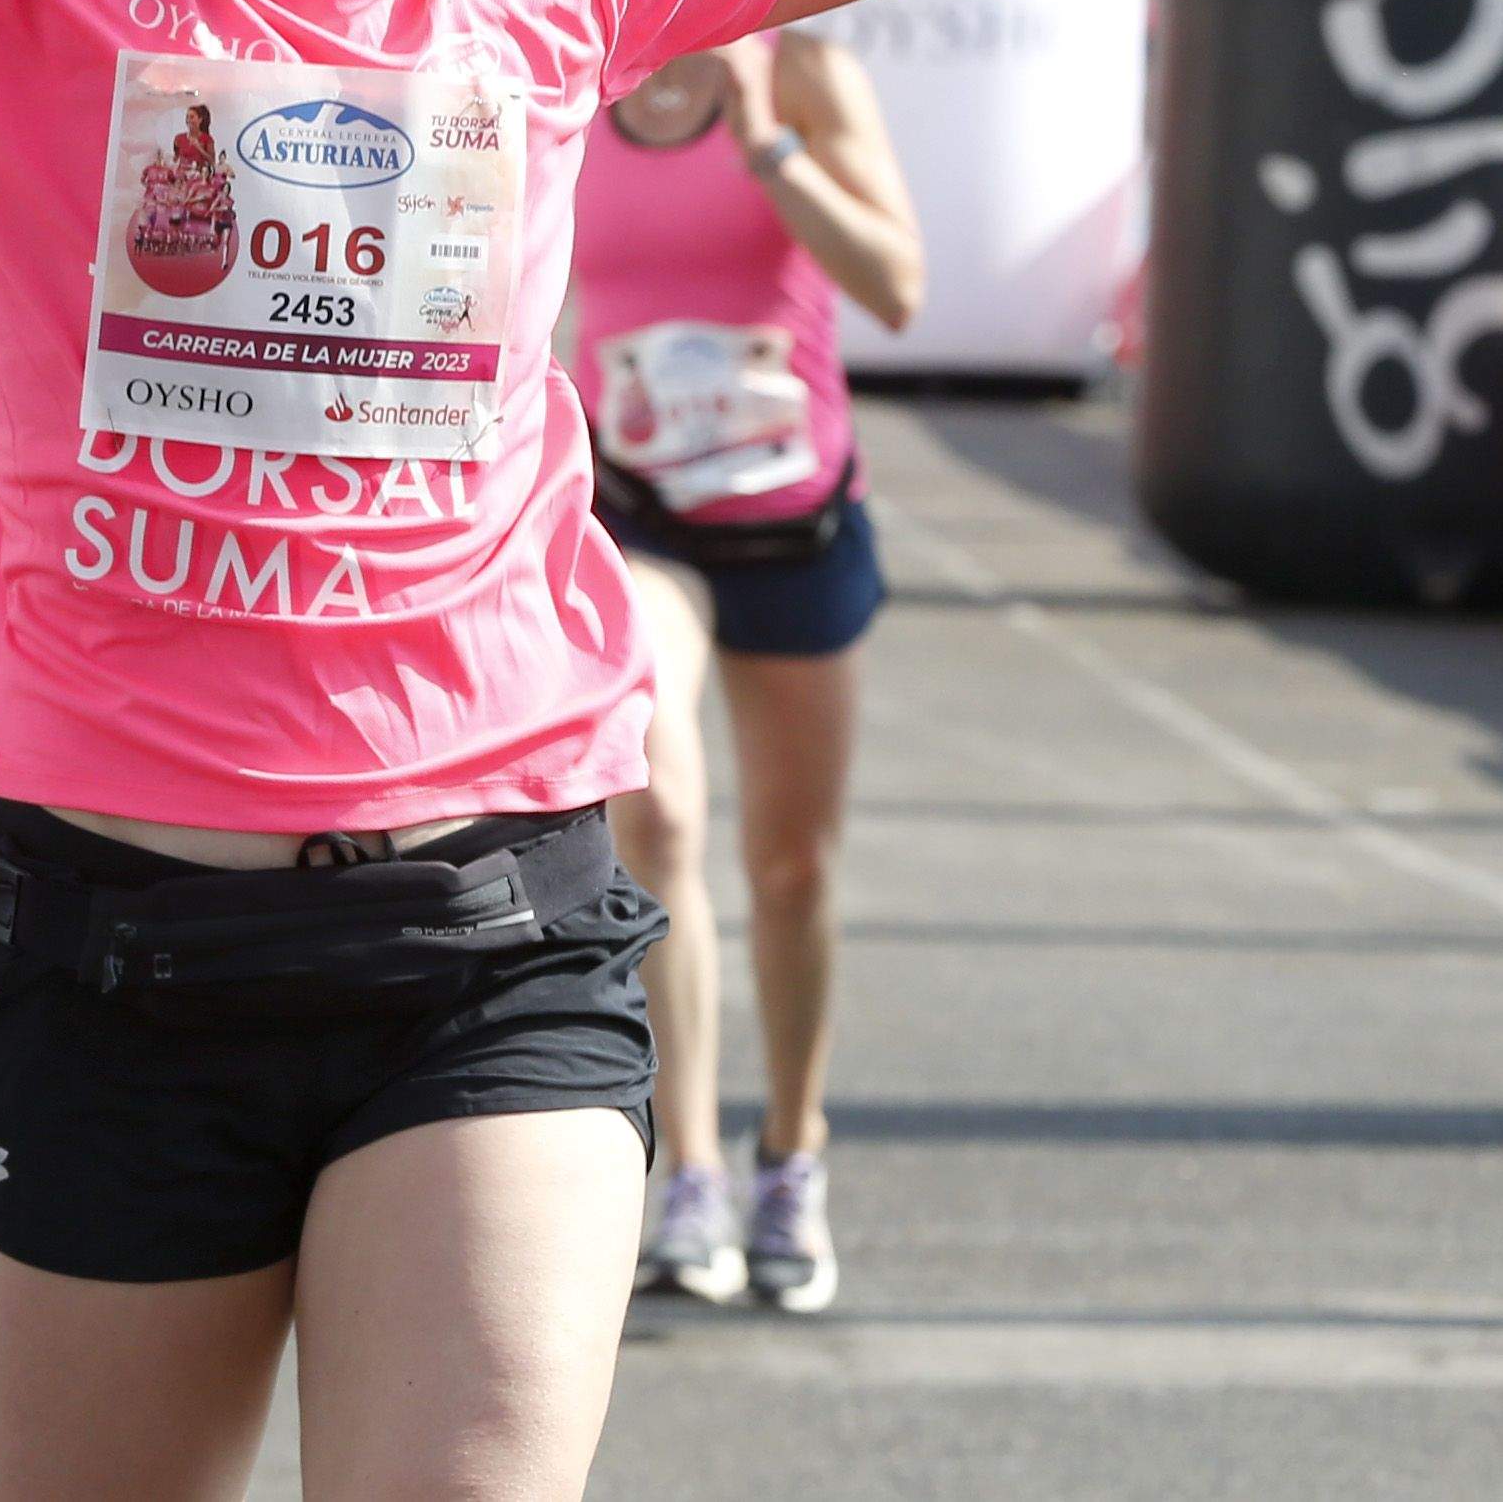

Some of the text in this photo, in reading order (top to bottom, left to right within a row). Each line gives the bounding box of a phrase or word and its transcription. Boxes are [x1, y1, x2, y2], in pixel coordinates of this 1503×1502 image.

[278, 128, 398, 144] CENTRAL LECHERA
[430, 128, 500, 151] SUMA
[432, 115, 502, 131] TU DORSAL
[250, 128, 401, 170] ASTURIANA
[250, 219, 386, 277] 016
[269, 291, 355, 327] 2453
[142, 329, 471, 373] CARRERA DE LA MUJER 2023
[126, 378, 471, 427] OYSHO Santander
[64, 495, 376, 618] SUMA
